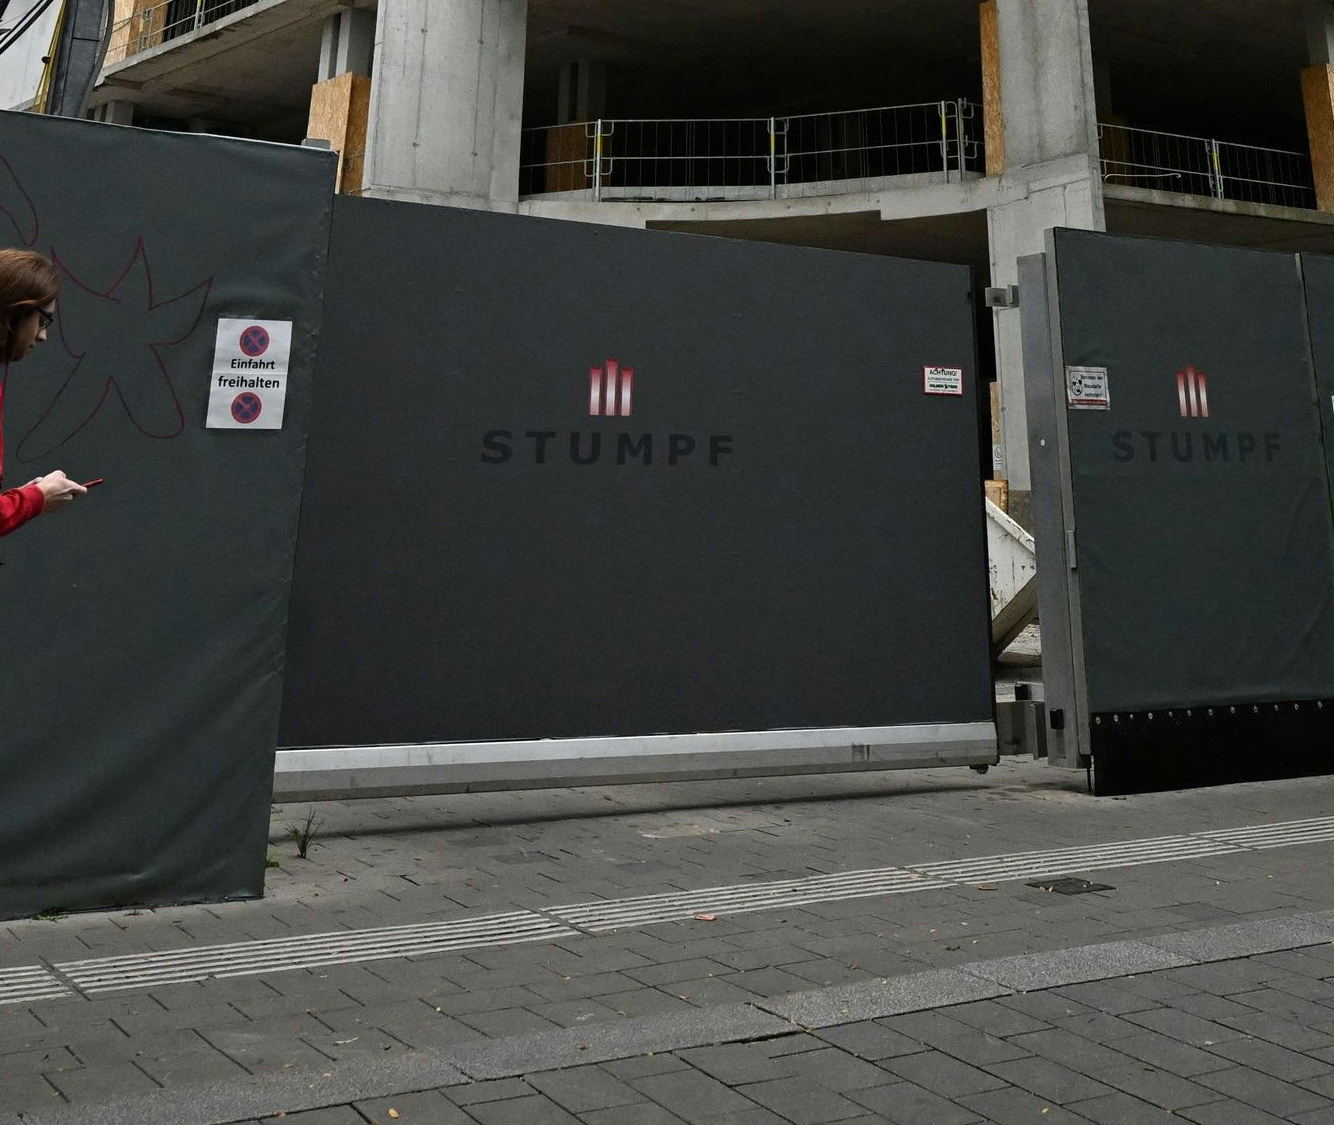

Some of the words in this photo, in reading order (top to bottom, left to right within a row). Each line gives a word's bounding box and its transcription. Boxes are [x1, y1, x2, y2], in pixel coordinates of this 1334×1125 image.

[230, 358, 275, 370] Einfahrt
[218, 376, 280, 389] freihalten
[480, 429, 733, 467] STUMPF
[1112, 431, 1281, 463] STUMPF
